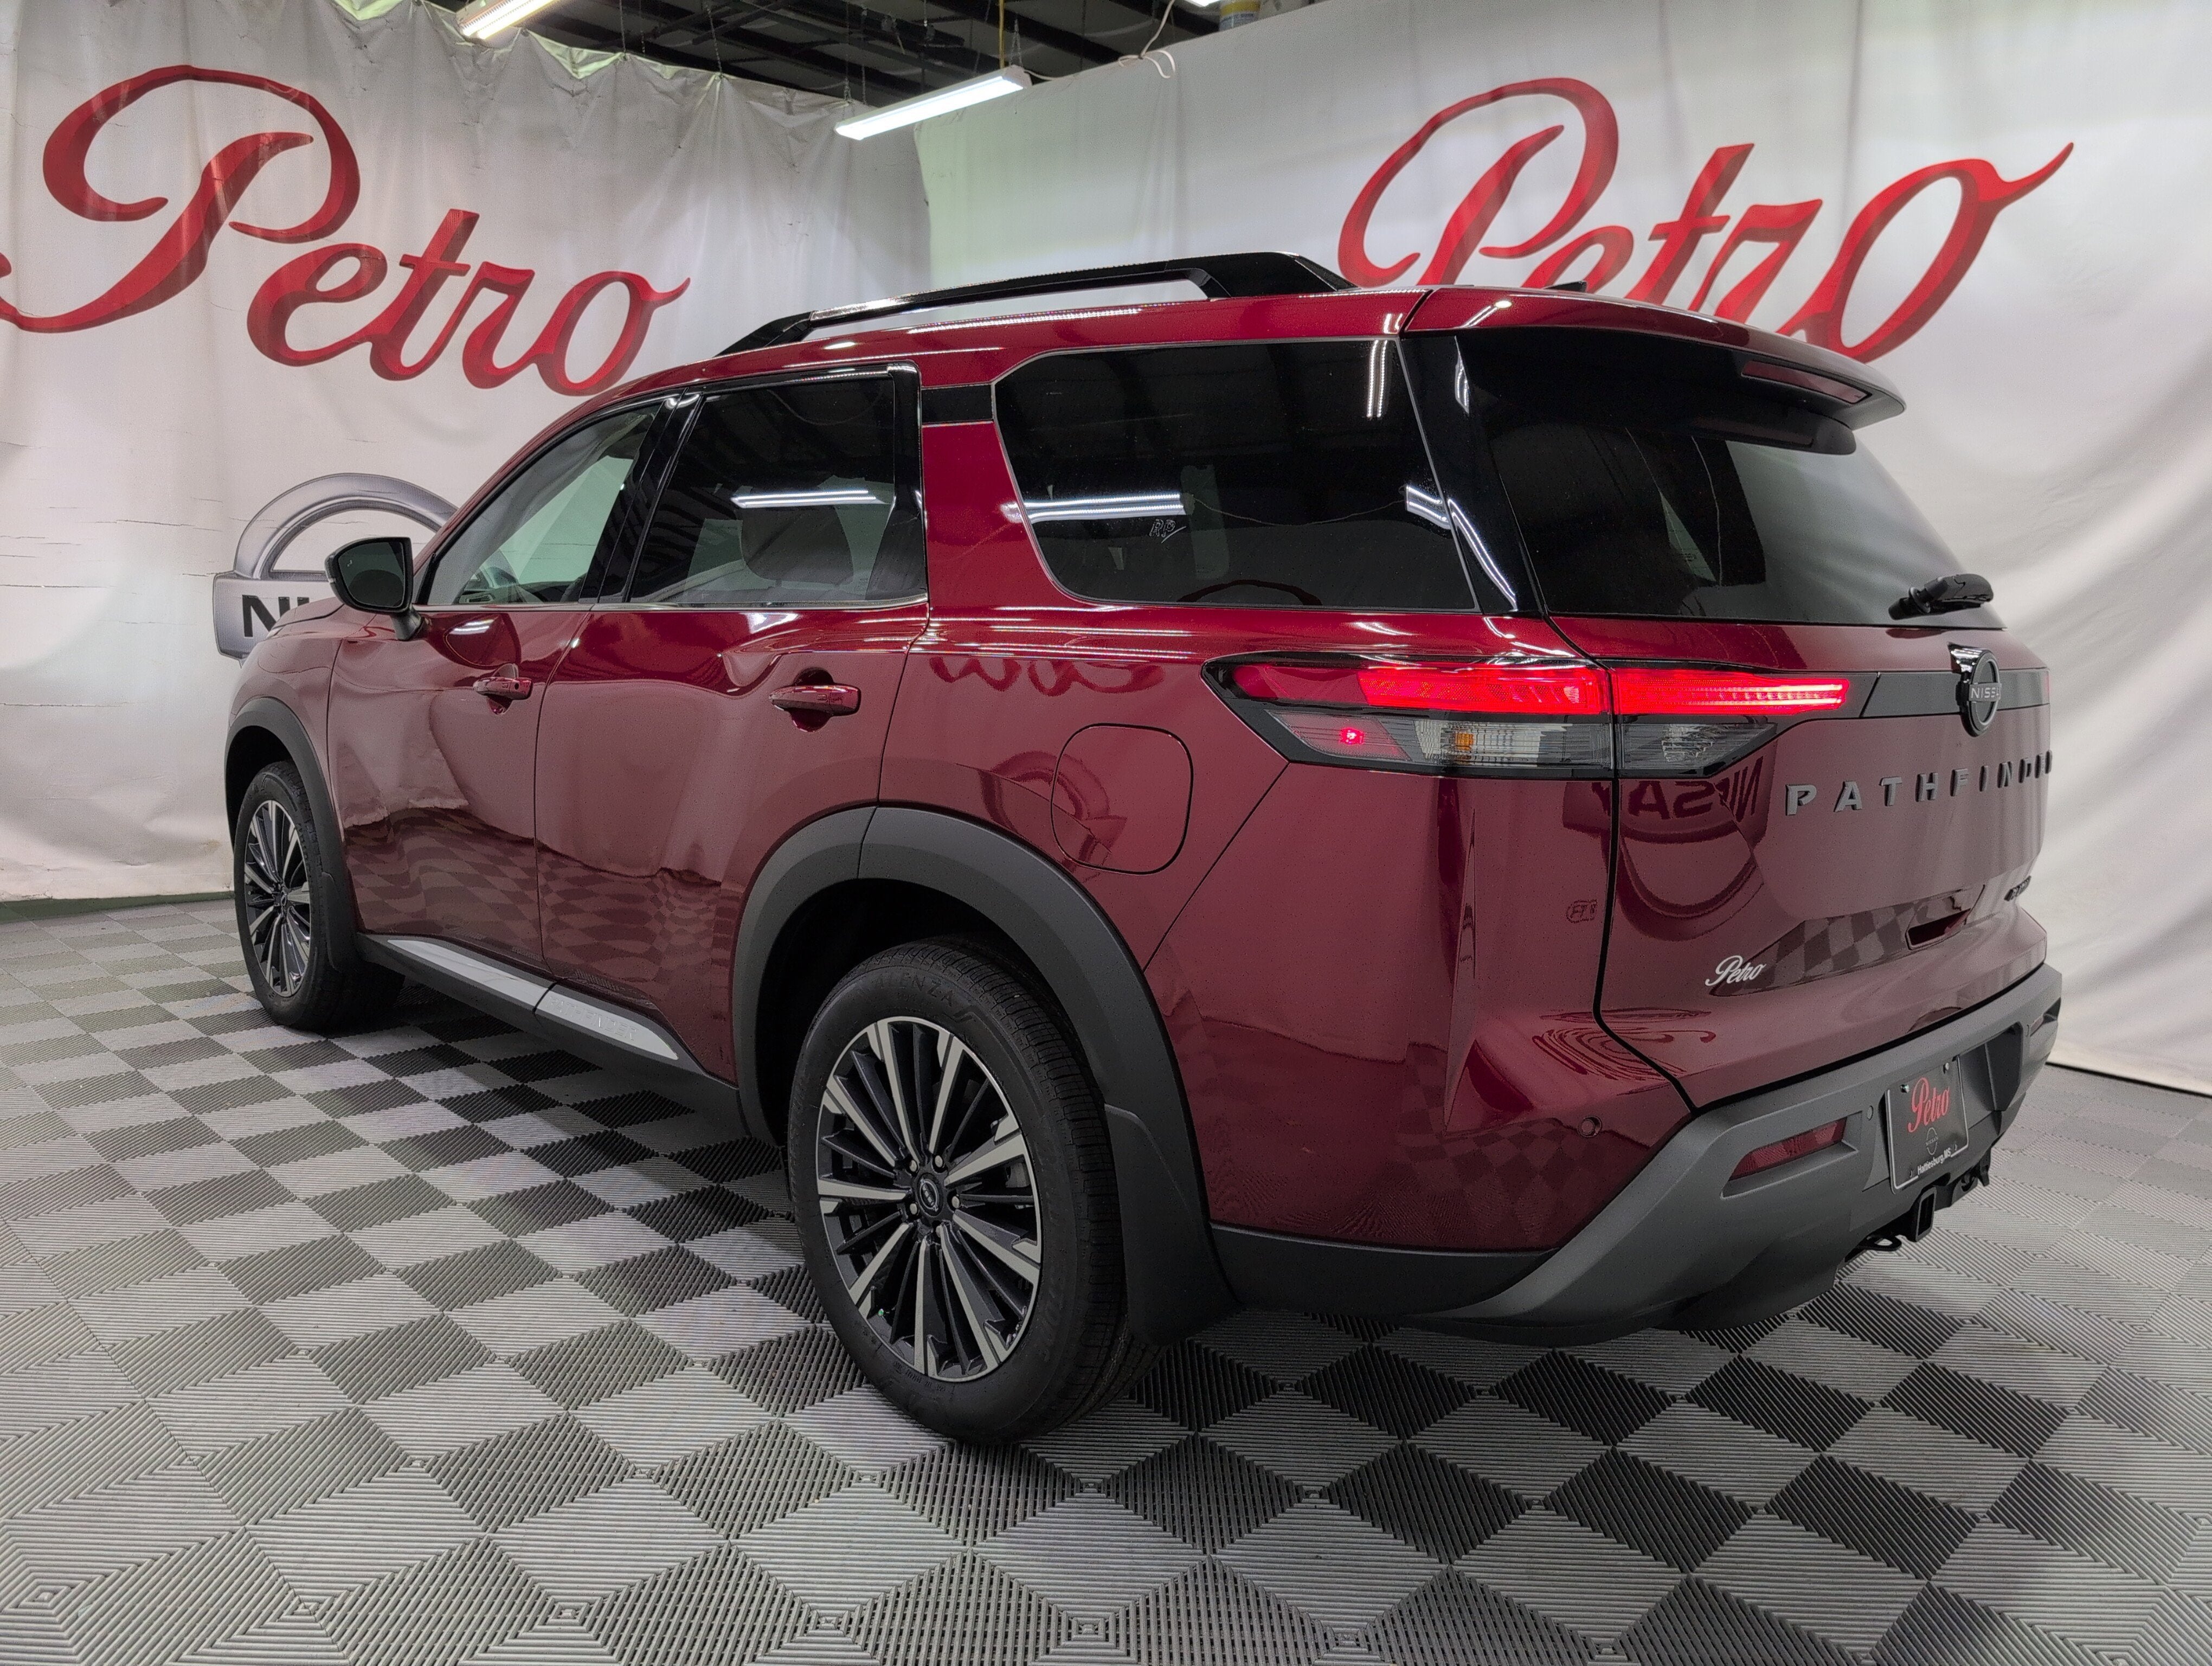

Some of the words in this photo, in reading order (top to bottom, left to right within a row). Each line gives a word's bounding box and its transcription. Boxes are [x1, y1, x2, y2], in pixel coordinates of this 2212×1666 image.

[0, 65, 690, 396] Petro
[1338, 77, 2074, 363] Petro
[1705, 955, 1767, 986] Petro
[1908, 1077, 1950, 1133] Petro
